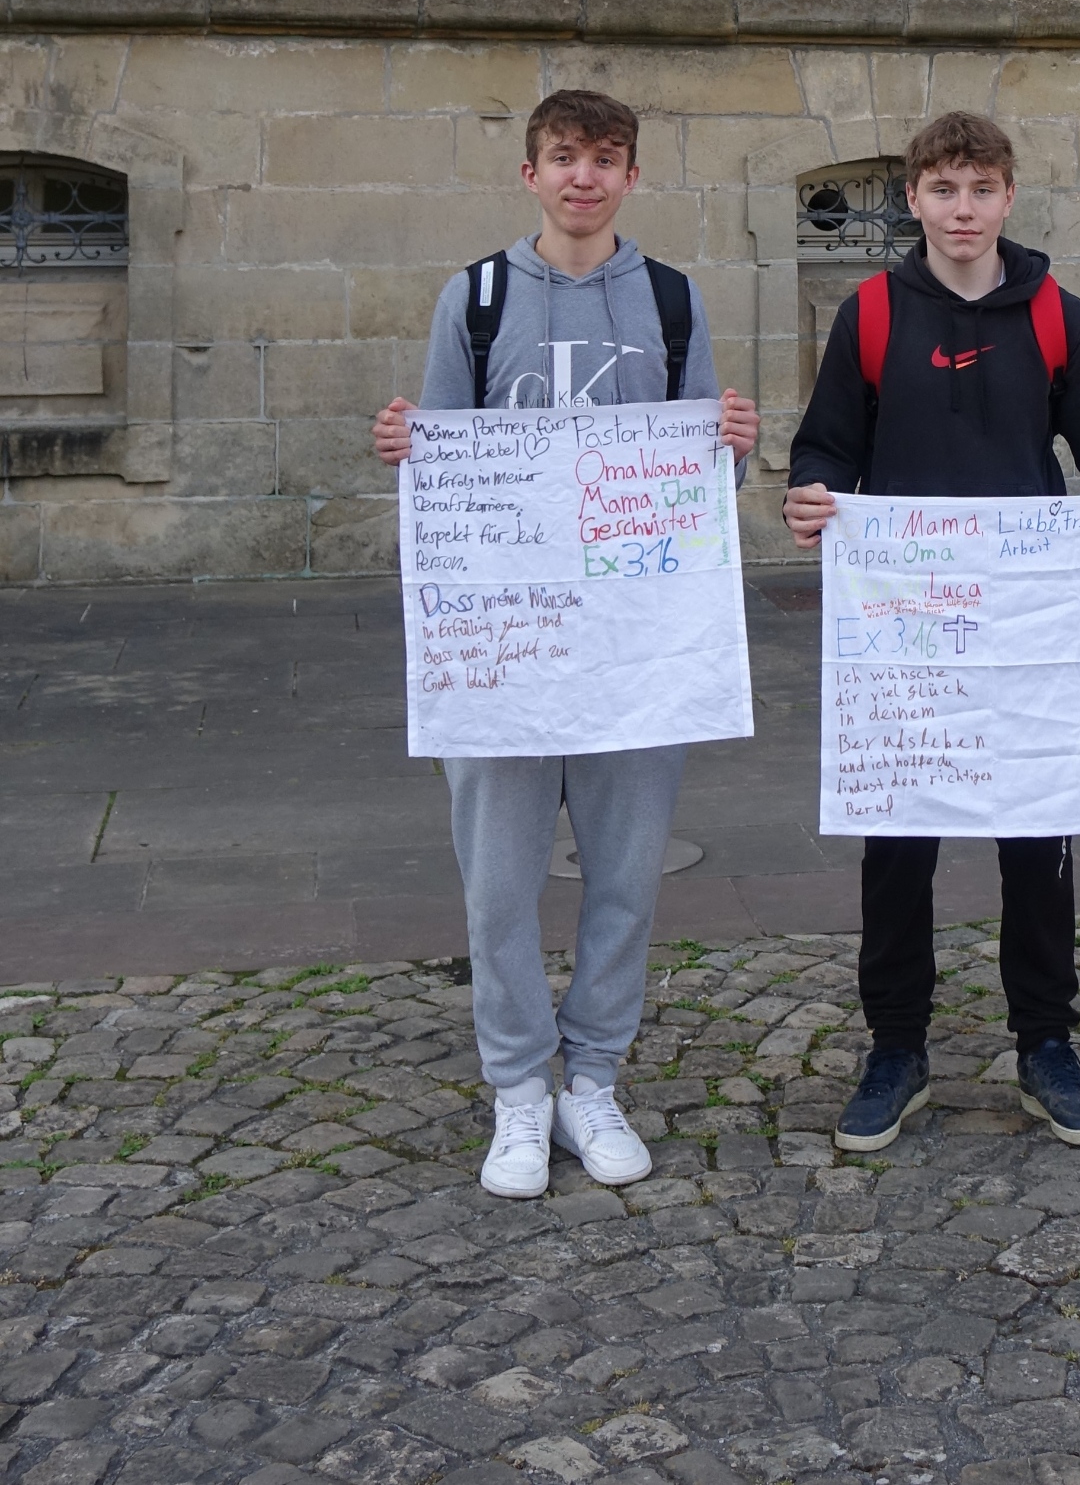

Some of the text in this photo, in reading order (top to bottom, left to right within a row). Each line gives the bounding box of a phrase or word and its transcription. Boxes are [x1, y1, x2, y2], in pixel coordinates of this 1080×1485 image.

[558, 391, 600, 408] Klein
[573, 415, 643, 449] Pastor
[478, 469, 490, 485] in
[576, 448, 701, 486] Oma Wanda
[661, 479, 706, 508] Jan
[583, 537, 679, 577] Ex 3,16
[903, 541, 955, 564] Oma
[999, 537, 1051, 558] Arbeit
[419, 582, 476, 617] Dass
[482, 588, 523, 612] meine
[422, 621, 434, 639] in
[837, 617, 938, 659] Ex 3,16
[836, 666, 949, 685] Ich wünsche
[835, 689, 859, 706] dir
[871, 684, 901, 702] viel
[839, 702, 935, 726] in deinem
[839, 754, 865, 774] und
[870, 753, 890, 771] ich
[937, 753, 954, 768] du
[837, 769, 992, 795] findest den richtigen
[846, 794, 893, 816] Beruf
